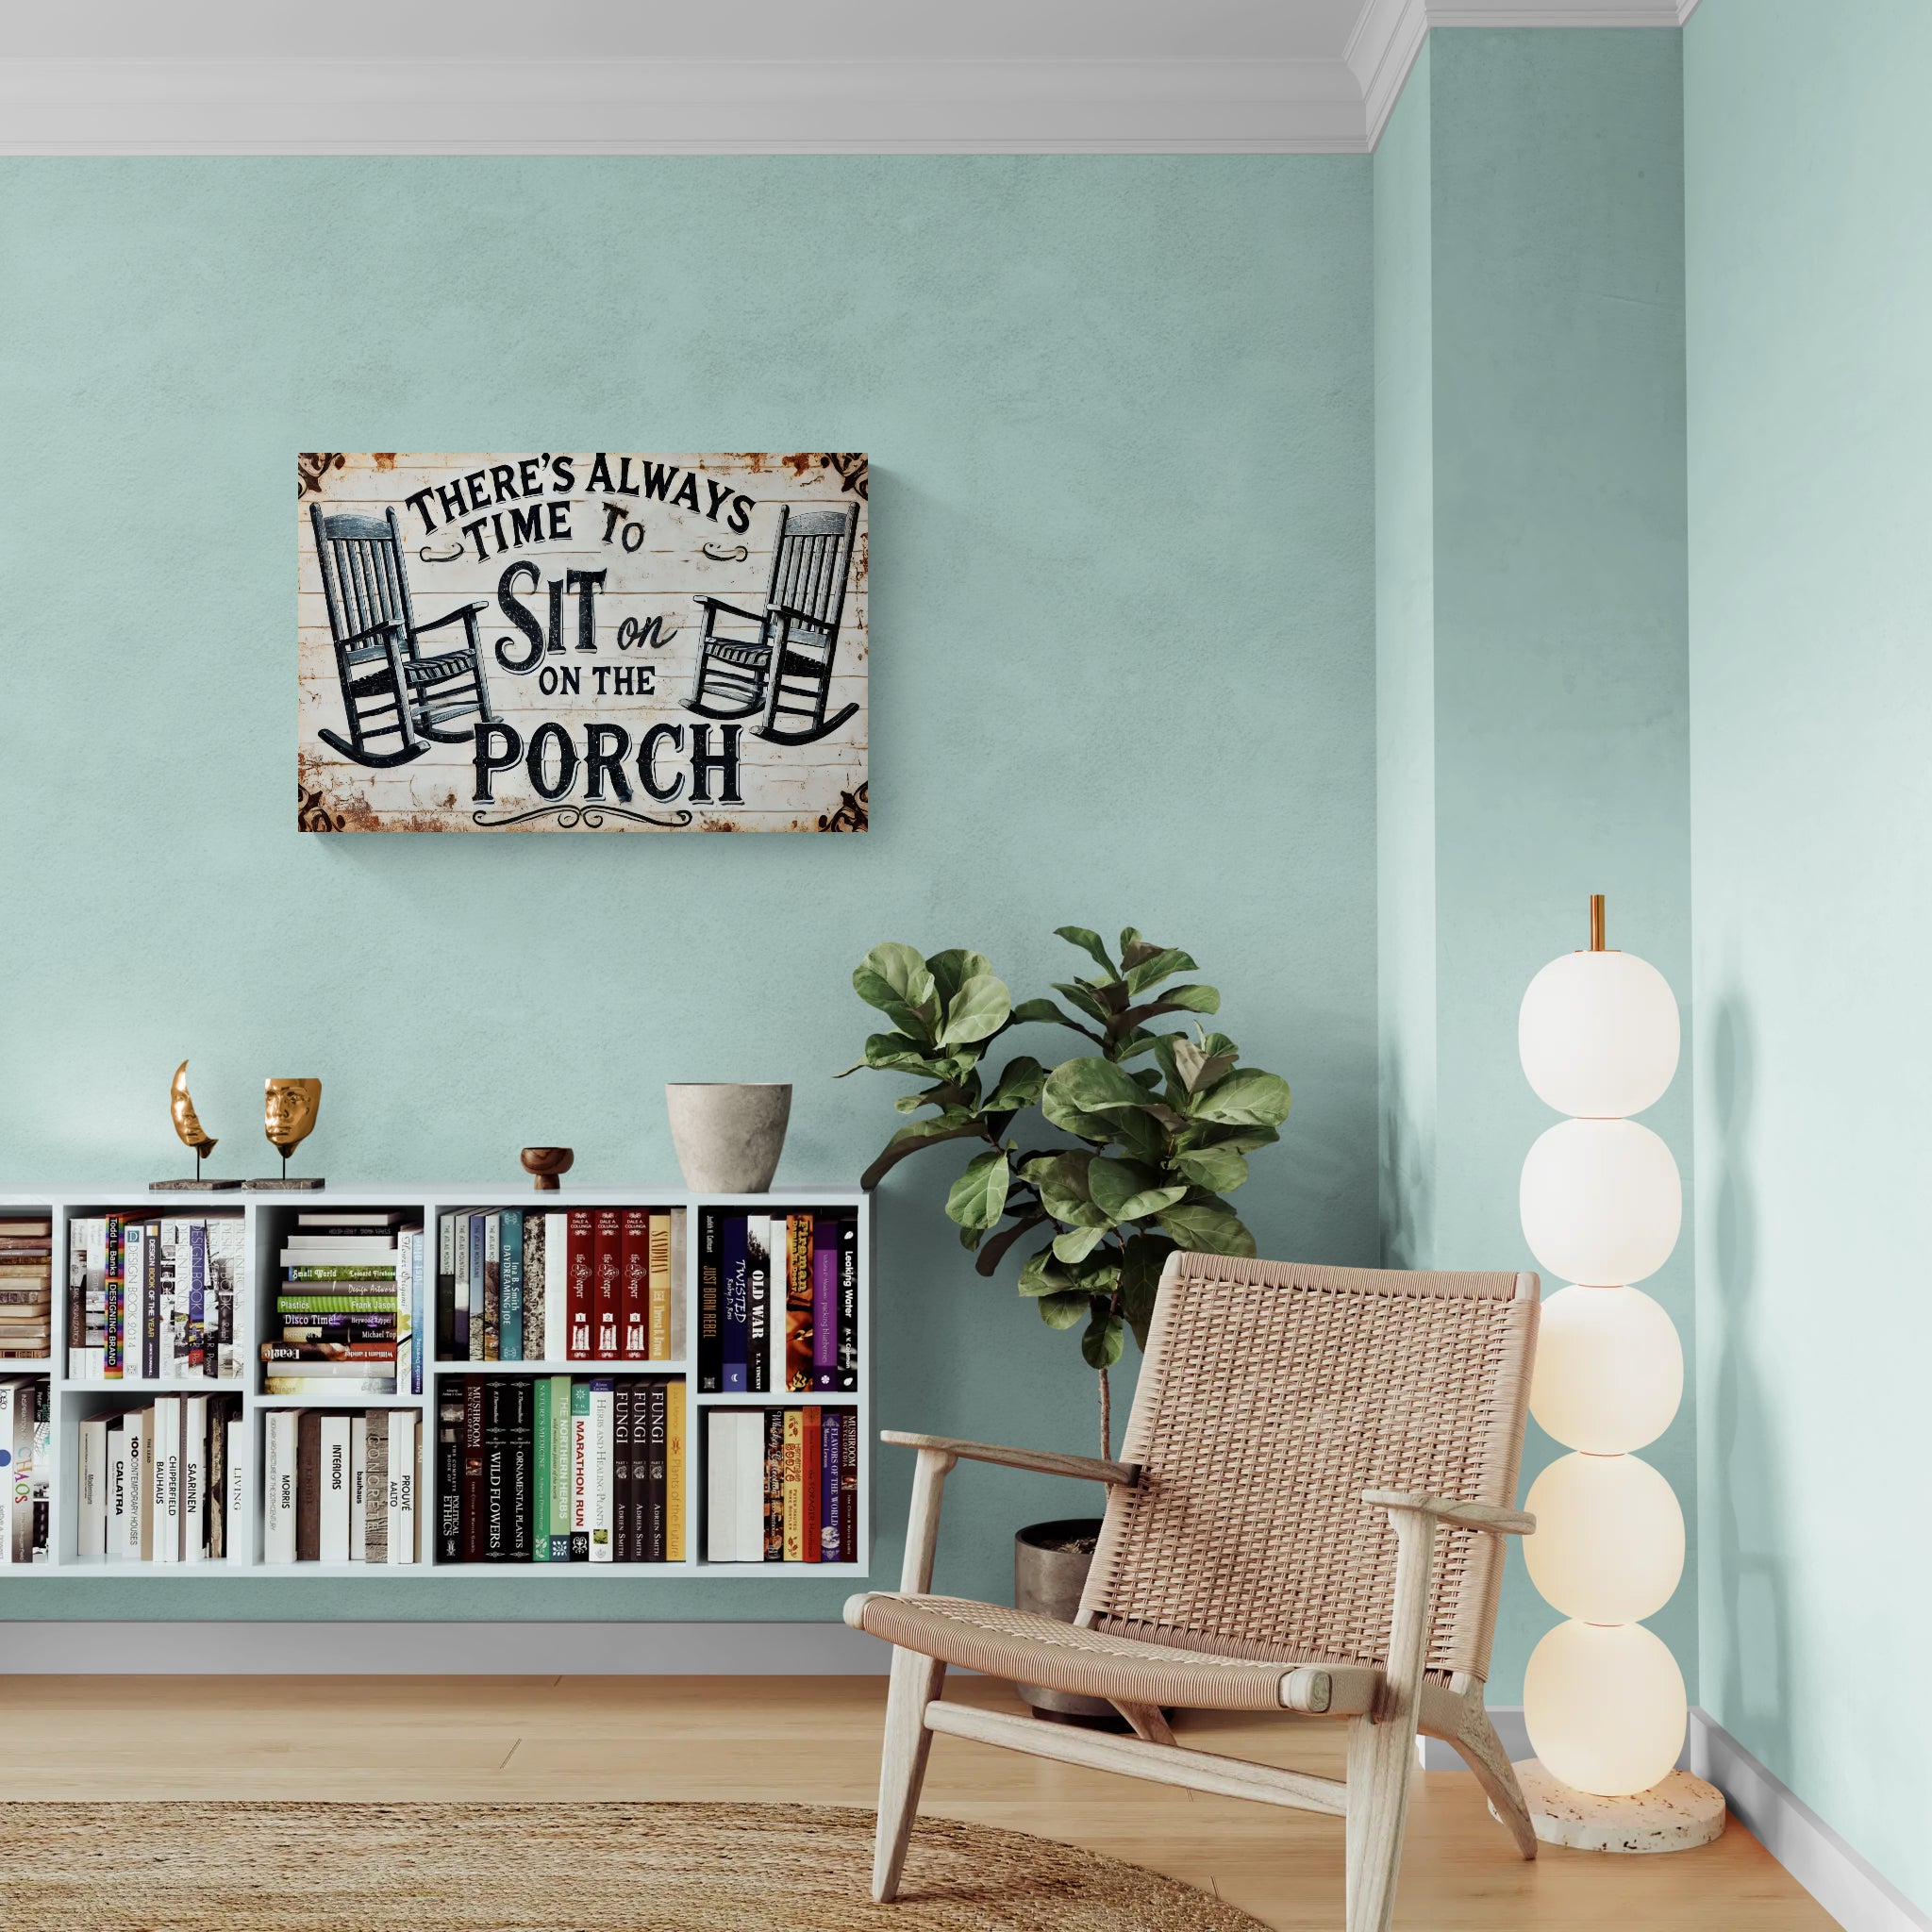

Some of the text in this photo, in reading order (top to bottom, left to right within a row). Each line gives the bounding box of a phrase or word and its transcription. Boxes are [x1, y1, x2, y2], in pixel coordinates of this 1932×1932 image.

[406, 453, 756, 536] THERE'S ALWAYS
[461, 501, 572, 563] TIME
[493, 559, 677, 675] SIT on
[539, 666, 656, 696] ON THE
[472, 721, 744, 805] PORCH
[192, 1225, 202, 1310] DESIGN BOOK
[401, 1236, 411, 1268] Flower
[413, 1237, 424, 1260] Blue
[511, 1262, 520, 1274] Ina
[651, 1230, 669, 1274] SANDMAN
[797, 1220, 809, 1292] Fireman
[843, 1251, 853, 1287] Leaking
[127, 1245, 139, 1349] DESIGN BOOK 2014
[148, 1290, 156, 1301] OF
[292, 1270, 312, 1279] Small
[348, 1284, 396, 1295] Design Artwork
[503, 1244, 511, 1325] DAYDREAMING JOE
[724, 1277, 734, 1320] Ruby D. Ross
[734, 1259, 746, 1324] TWISTED
[281, 1301, 396, 1309] Plastics Frank Jason
[285, 1315, 308, 1324] Disco
[511, 1287, 520, 1311] Smith
[703, 1265, 716, 1339] JUST BORN REBEL
[752, 1270, 764, 1340] OLD WAR
[108, 1284, 117, 1366] DESIGNING BRAND
[821, 1302, 829, 1363] packing blueberries
[264, 1348, 300, 1359] Beagle
[473, 1386, 481, 1447] MUSHROOM
[596, 1399, 607, 1428] HERBS
[616, 1391, 628, 1444] FUNGI
[633, 1391, 646, 1444] FUNGI
[651, 1391, 664, 1444] FUNGI
[771, 1410, 782, 1449] Whiskey
[559, 1396, 569, 1520] THE NORTHERN HERBS
[575, 1421, 584, 1496] MARATHON
[596, 1429, 605, 1449] AND
[848, 1415, 857, 1467] MUSHROOM
[14, 1446, 33, 1504] CHAOS
[156, 1461, 164, 1505] BAUHAUS
[168, 1456, 176, 1516] CHIPPERFIELD
[187, 1463, 196, 1513] SAARINEN
[332, 1444, 341, 1491] INTERIORS
[368, 1435, 380, 1530] CONCRETE
[491, 1451, 501, 1485] WILD
[596, 1451, 607, 1491] HEALING
[831, 1465, 839, 1476] OF
[390, 1481, 398, 1507] AALTO
[402, 1474, 412, 1511] PROUVÉ
[443, 1495, 452, 1537] ETHICS
[515, 1451, 524, 1549] ORNAMENTAL PLANTS
[575, 1499, 584, 1526] RUN
[596, 1493, 607, 1526] PLANTS
[672, 1458, 681, 1557] Plants of the Future
[130, 1516, 139, 1545] HOUSES
[491, 1488, 501, 1549] FLOWERS
[653, 1503, 661, 1557] ADRIEN SMITH
